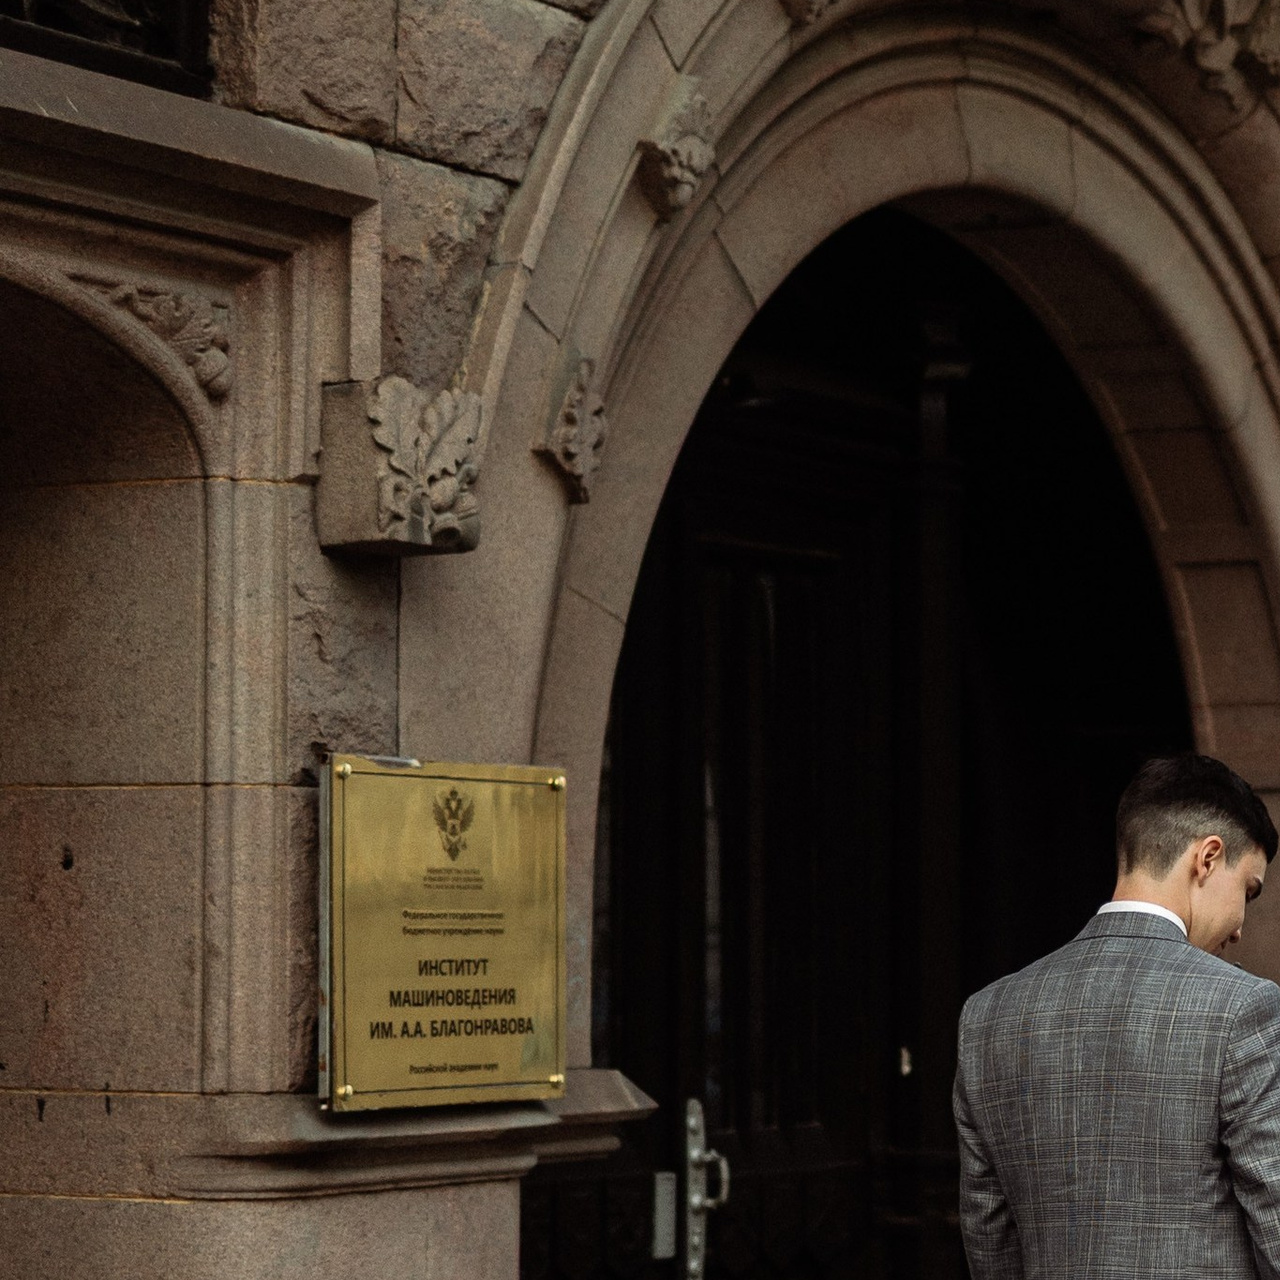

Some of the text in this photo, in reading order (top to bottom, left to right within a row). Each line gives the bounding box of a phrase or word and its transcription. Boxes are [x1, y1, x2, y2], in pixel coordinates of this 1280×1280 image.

[418, 959, 488, 977] ИНСТИТУТ
[389, 988, 516, 1010] МАШИНОВЕДЕНИЯ
[370, 1018, 534, 1039] ИМ. А.А. БЛАГОНРАВОВА
